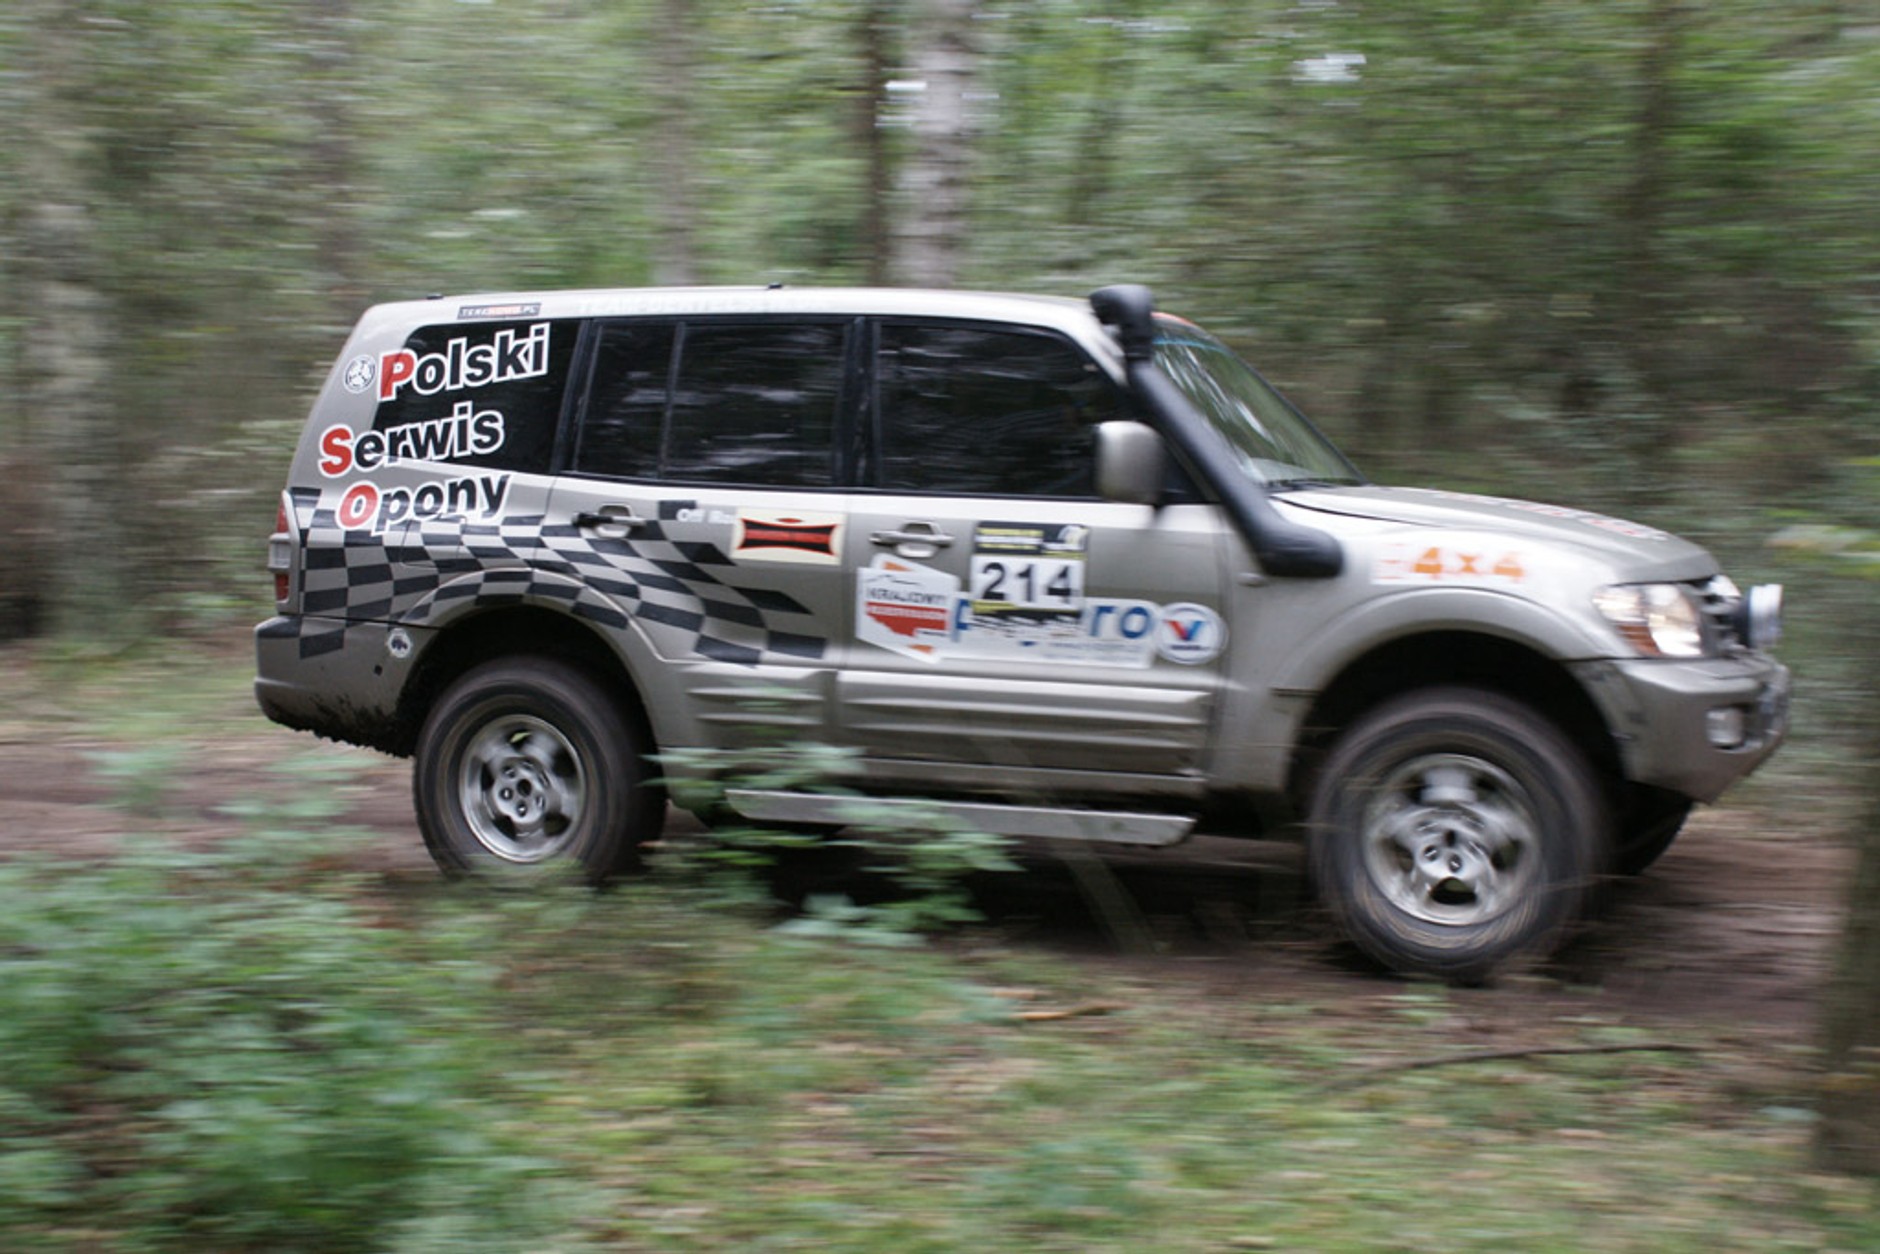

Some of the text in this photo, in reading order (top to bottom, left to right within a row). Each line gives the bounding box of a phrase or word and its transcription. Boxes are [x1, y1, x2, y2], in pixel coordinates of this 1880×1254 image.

[378, 322, 550, 401] Polski
[318, 401, 505, 478] Serwis
[336, 473, 512, 536] Opony
[982, 562, 1075, 604] 214
